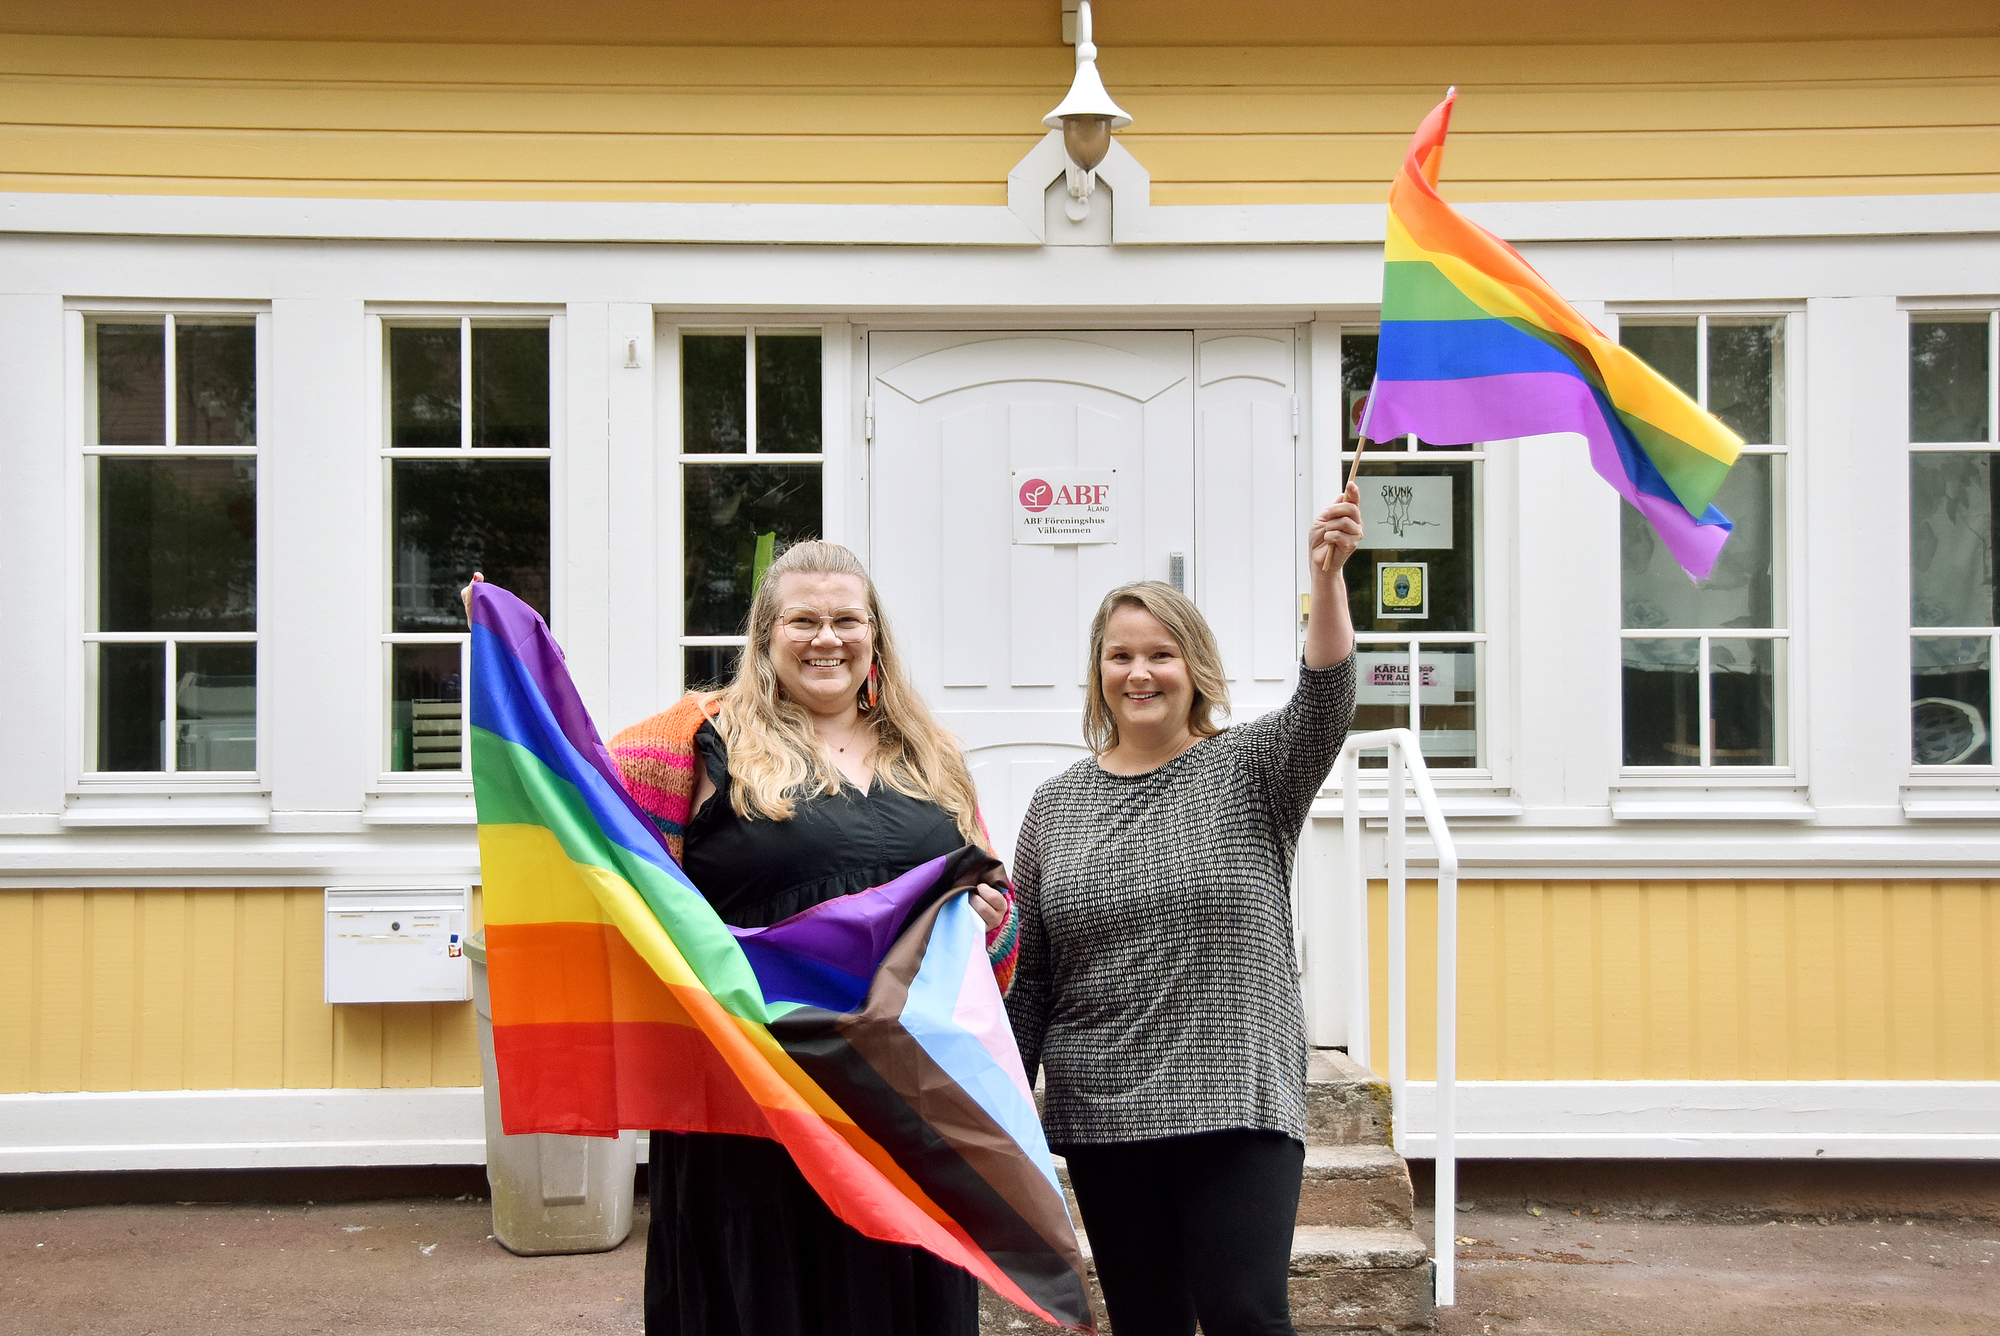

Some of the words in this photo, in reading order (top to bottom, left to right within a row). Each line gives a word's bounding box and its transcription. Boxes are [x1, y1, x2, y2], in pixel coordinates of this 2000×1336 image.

[1053, 485, 1109, 505] ABF
[1381, 485, 1413, 498] SKUNK
[1023, 517, 1043, 525] ABF
[1045, 516, 1105, 526] Föreningshus
[1037, 526, 1091, 534] Välkommen
[1374, 663, 1409, 673] KÄRLE
